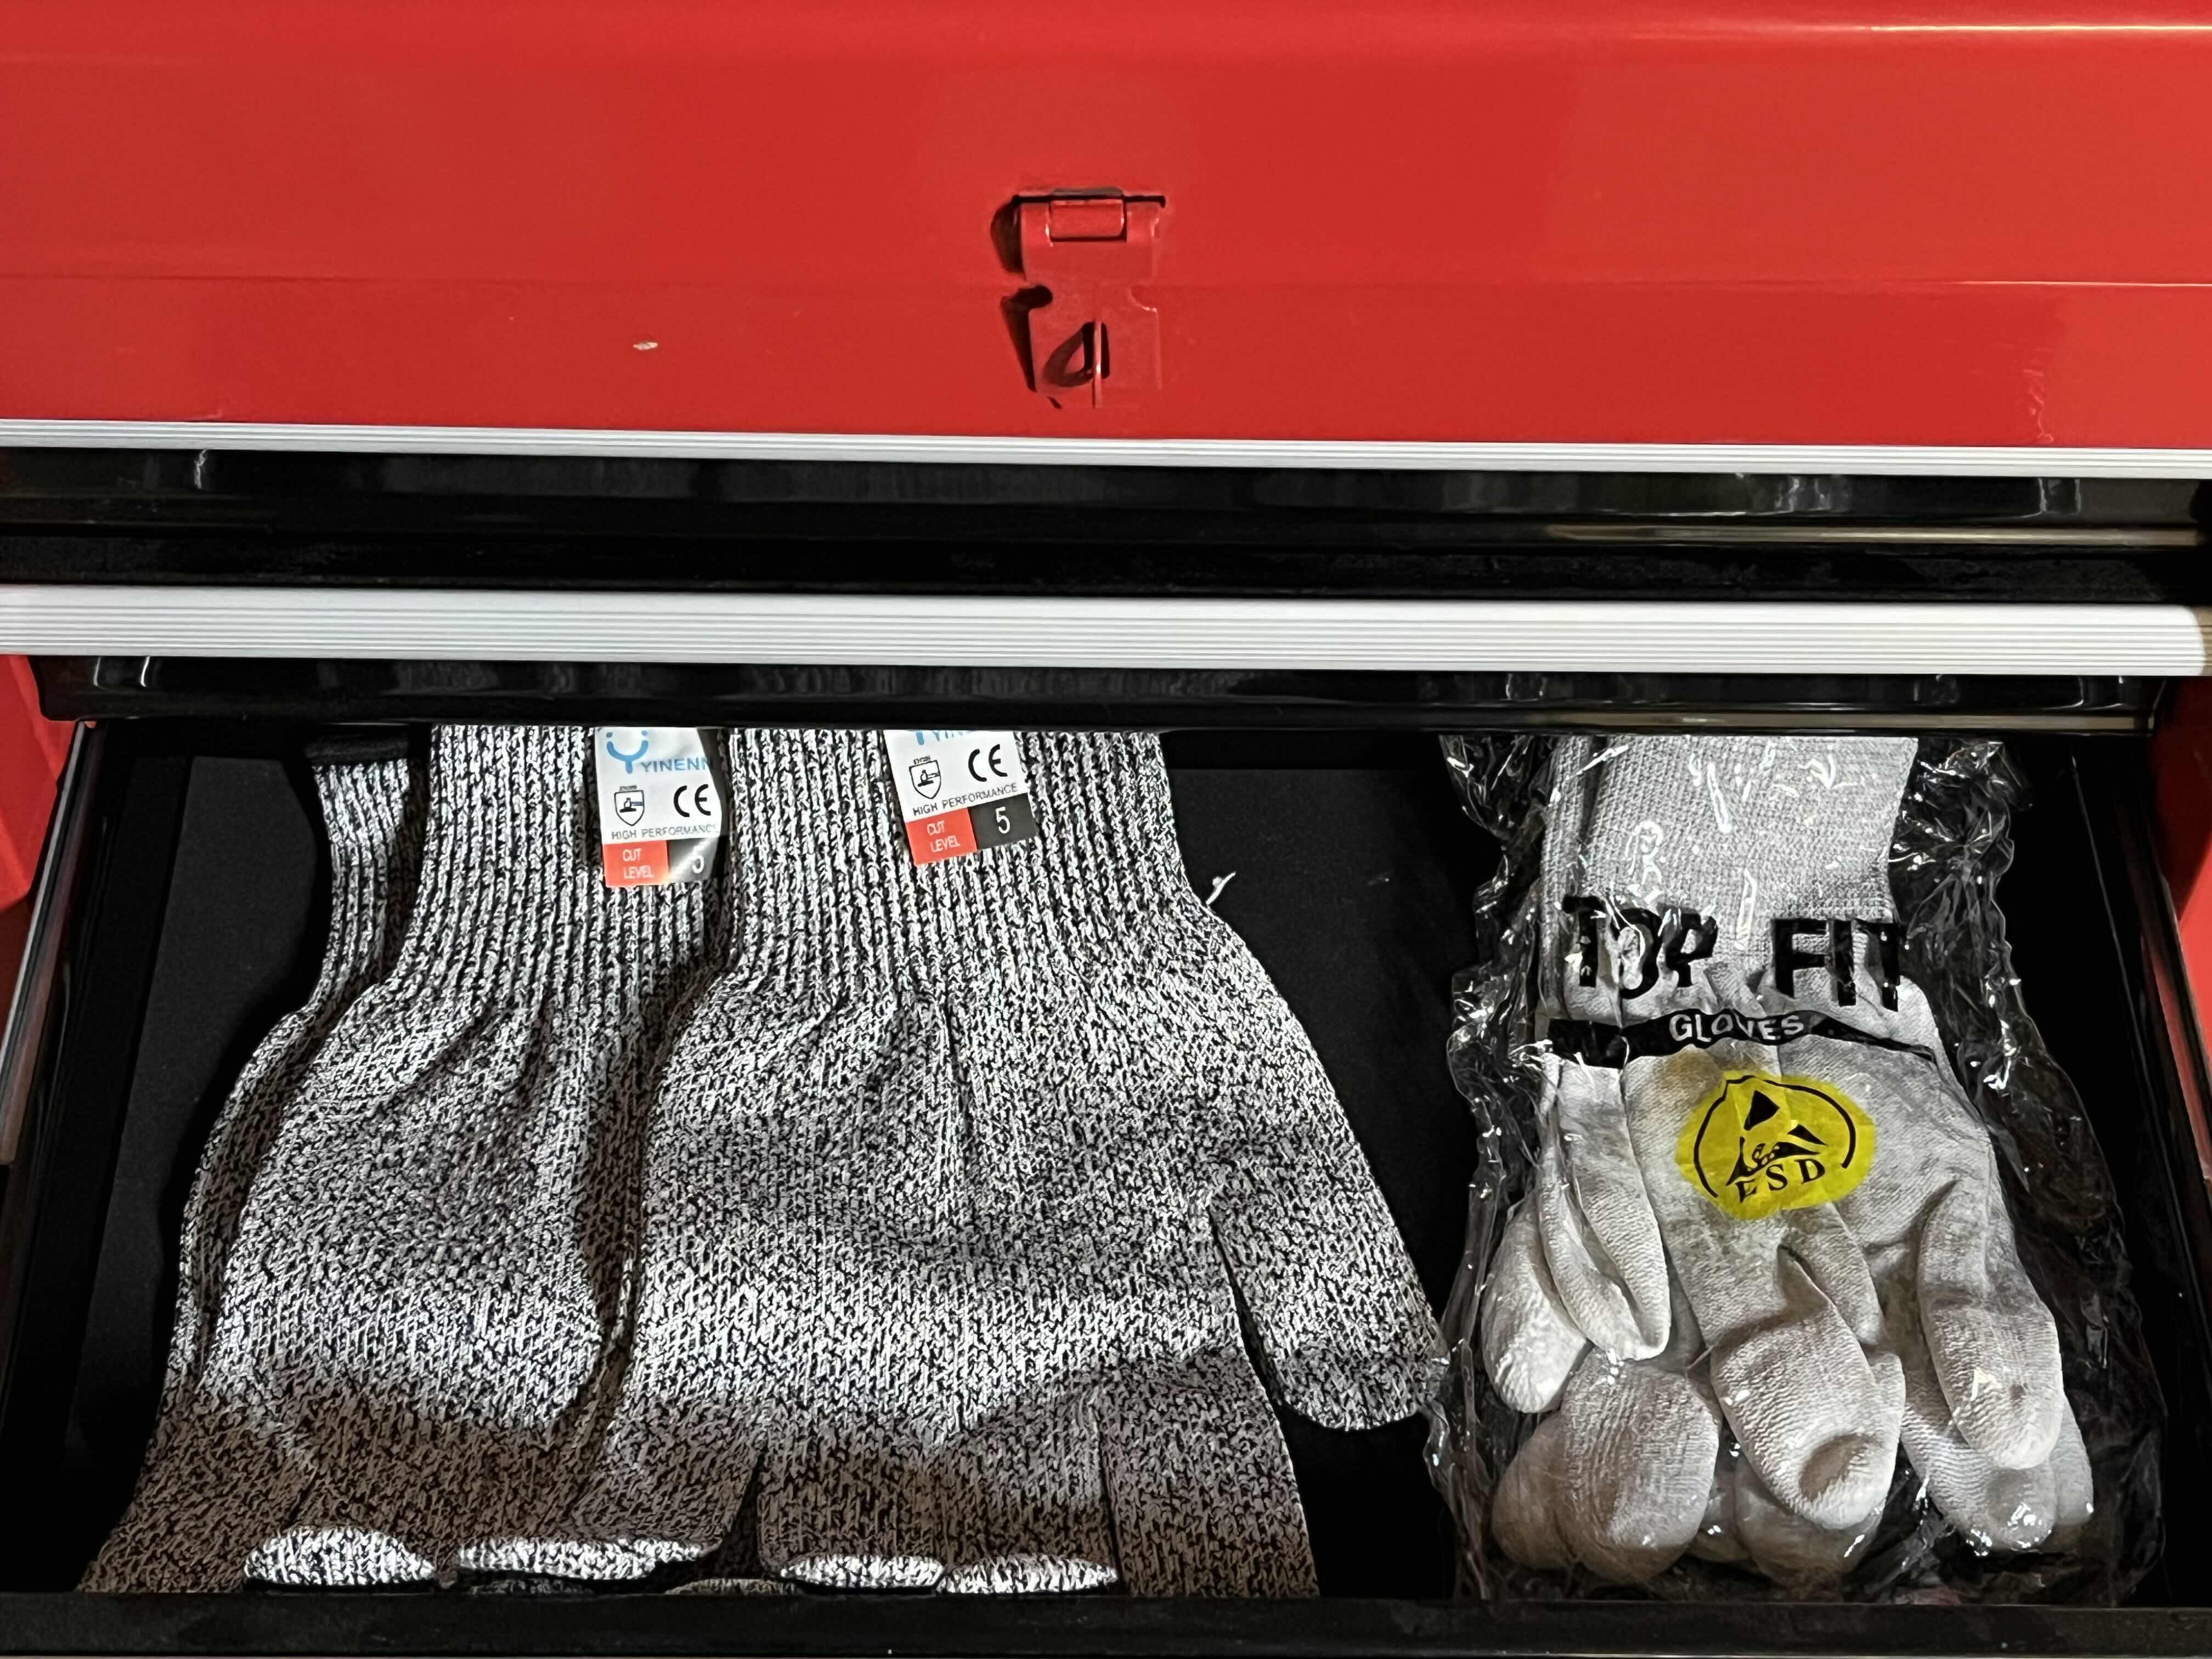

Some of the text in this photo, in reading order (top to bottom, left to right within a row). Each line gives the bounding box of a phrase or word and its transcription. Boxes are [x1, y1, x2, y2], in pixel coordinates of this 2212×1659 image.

[968, 744, 1008, 782] CE
[674, 783, 711, 817] CE
[913, 782, 1018, 817] HIGH PERFORMANCE
[611, 830, 637, 840] HIGH
[927, 821, 945, 836] CUT
[995, 806, 1011, 834] 5
[930, 835, 961, 853] LEVEL
[623, 865, 654, 879] LEVEL
[1562, 895, 1906, 1012] TOP FIT
[1669, 1008, 1804, 1043] GLOVES
[1735, 1158, 1826, 1204] ESD
